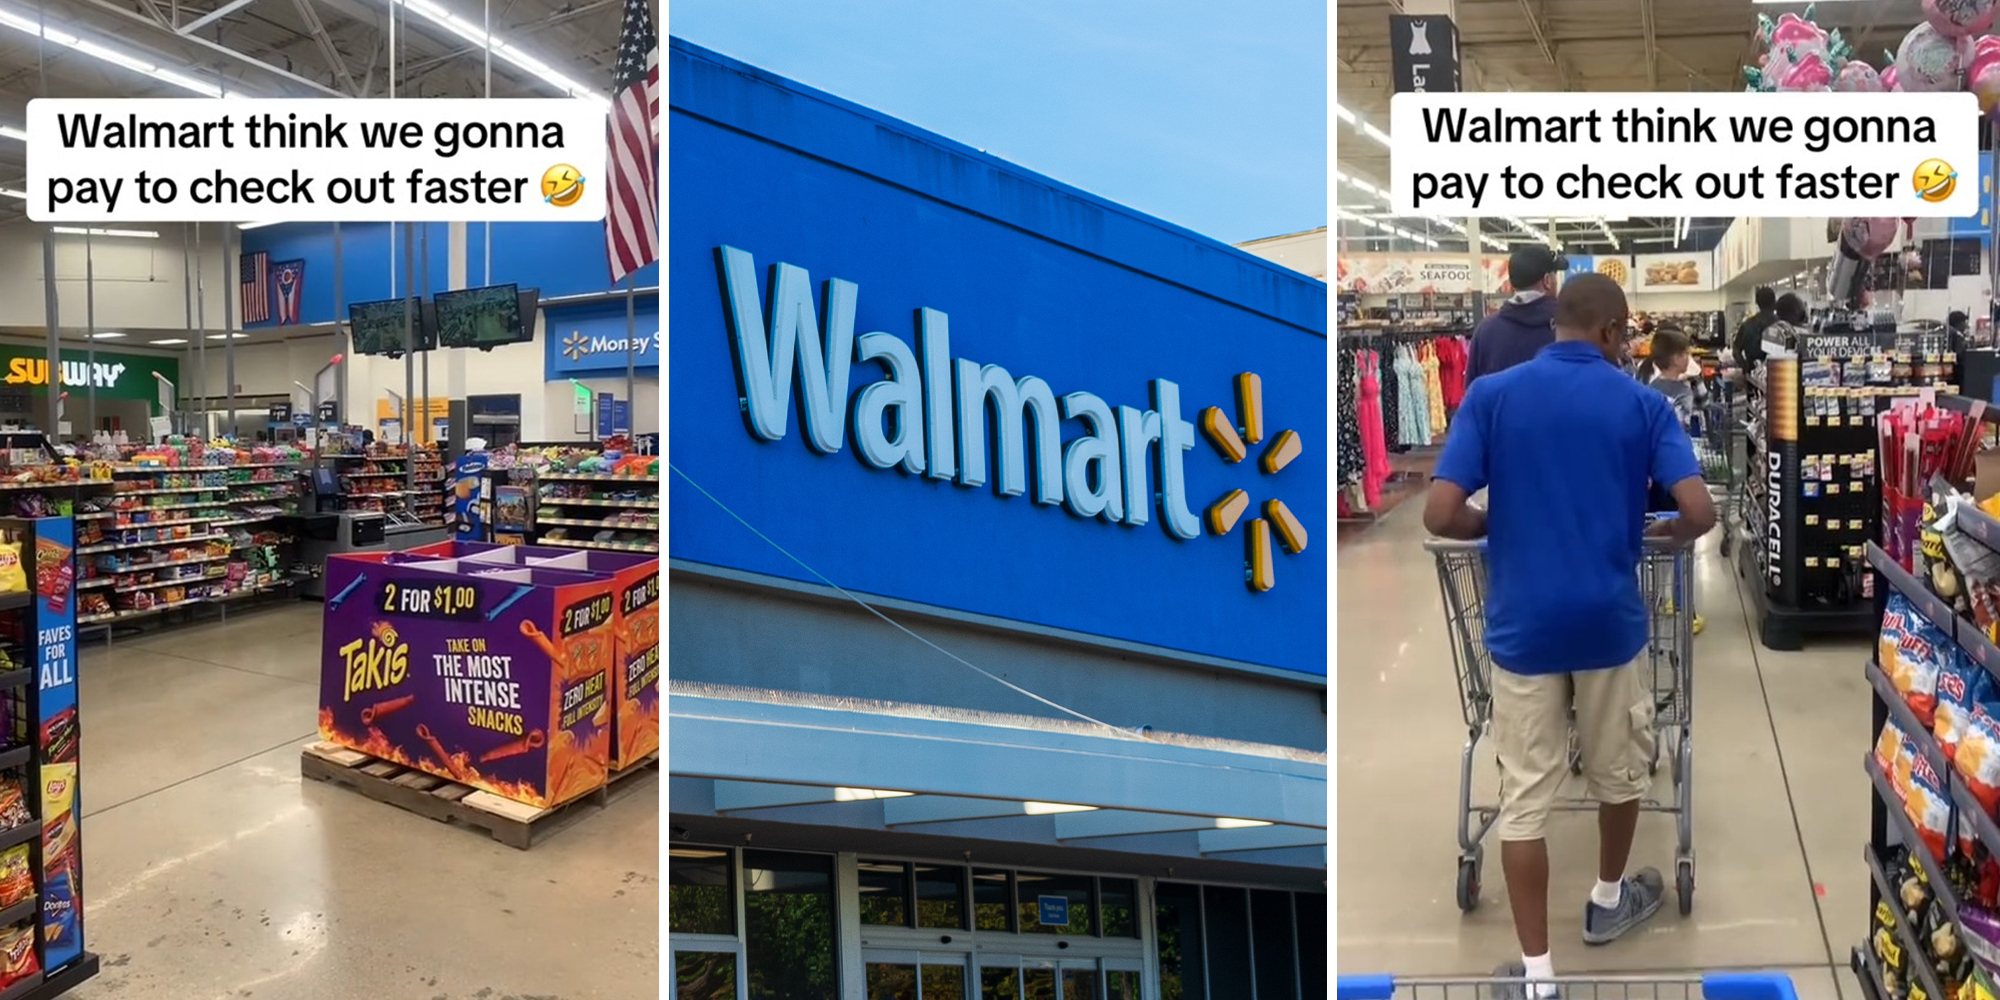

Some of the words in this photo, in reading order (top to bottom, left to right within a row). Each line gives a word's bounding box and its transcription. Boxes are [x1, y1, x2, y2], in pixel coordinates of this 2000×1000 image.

[591, 335, 650, 355] Money
[1807, 336, 1849, 347] POWER
[1851, 336, 1870, 346] ALL
[1807, 347, 1837, 358] YOUR
[5, 357, 126, 388] SUWAY
[713, 244, 1200, 542] Walmart
[384, 583, 396, 612] 2
[401, 588, 430, 613] FOR
[434, 585, 475, 615] $1.00
[624, 590, 631, 612] 2
[632, 586, 647, 607] FOR
[564, 609, 573, 633] 2
[573, 607, 590, 630] FOR
[38, 625, 72, 647] FAVES
[446, 638, 470, 653] TAKE
[472, 638, 486, 652] ON
[45, 645, 65, 662] FOR
[339, 627, 409, 702] Takis
[39, 658, 73, 690] ALL
[433, 654, 463, 678] THE
[467, 655, 511, 680] MOST
[628, 655, 646, 682] ZERO
[445, 677, 521, 709] INTENSE
[564, 683, 584, 711] ZERO
[584, 672, 605, 699] HEAT
[468, 706, 523, 736] SNACKS
[43, 899, 71, 912] Doritos
